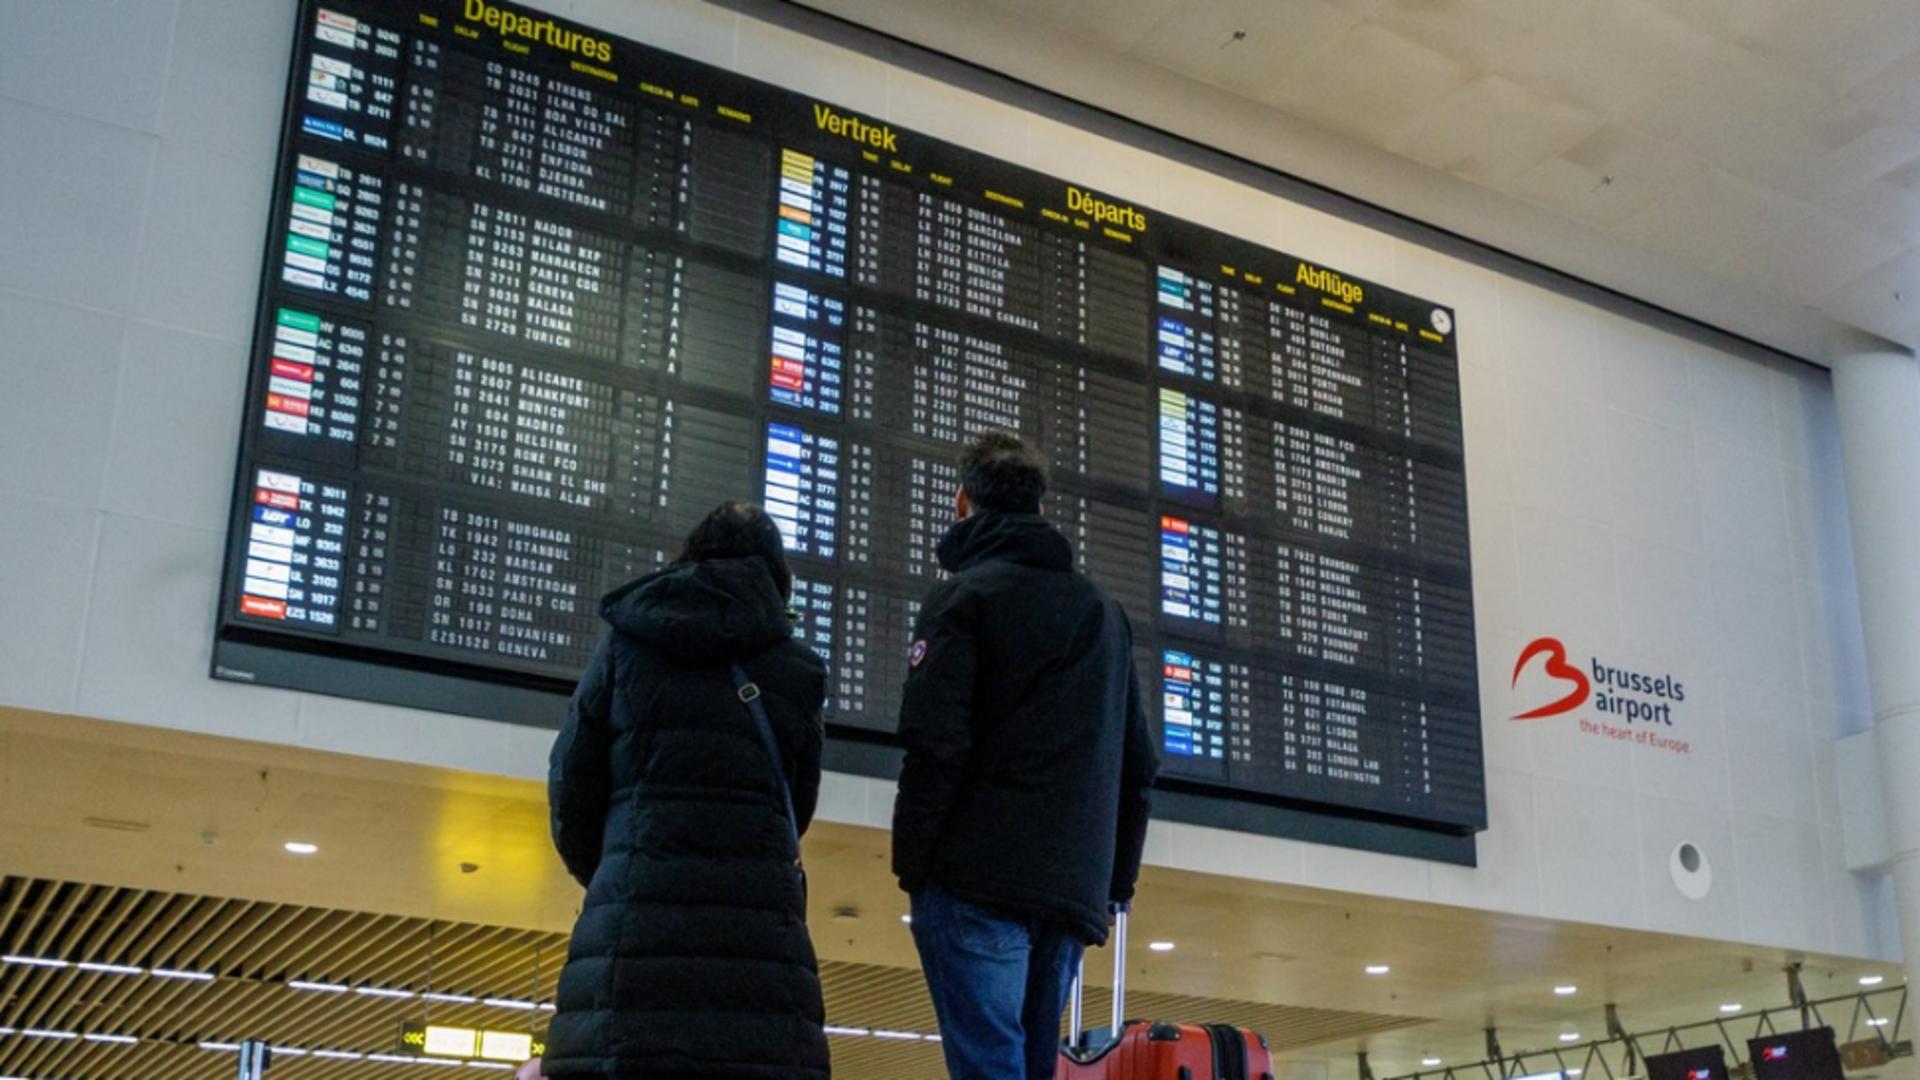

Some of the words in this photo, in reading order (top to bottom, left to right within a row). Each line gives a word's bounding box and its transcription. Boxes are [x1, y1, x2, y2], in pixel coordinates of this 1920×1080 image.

[463, 0, 612, 63] Departures
[813, 103, 898, 152] Vertrek
[1066, 185, 1146, 232] Départs
[1296, 262, 1363, 304] Abflüge
[506, 521, 571, 543] HURGHADA
[507, 538, 569, 560] ISTANBUL
[504, 555, 553, 573] WARSAW
[503, 572, 576, 595] AMSTERDAM
[502, 588, 543, 606] PARIS
[550, 597, 575, 612] CDG
[500, 605, 533, 622] DOHA
[498, 623, 571, 645] ROVANIEMI
[497, 640, 547, 659] GENEVA
[1591, 656, 1685, 702] brussels
[1595, 687, 1673, 726] airport
[1579, 718, 1600, 735] the
[1602, 722, 1633, 742] heart
[1635, 730, 1648, 743] of
[1649, 732, 1690, 754] Europe
